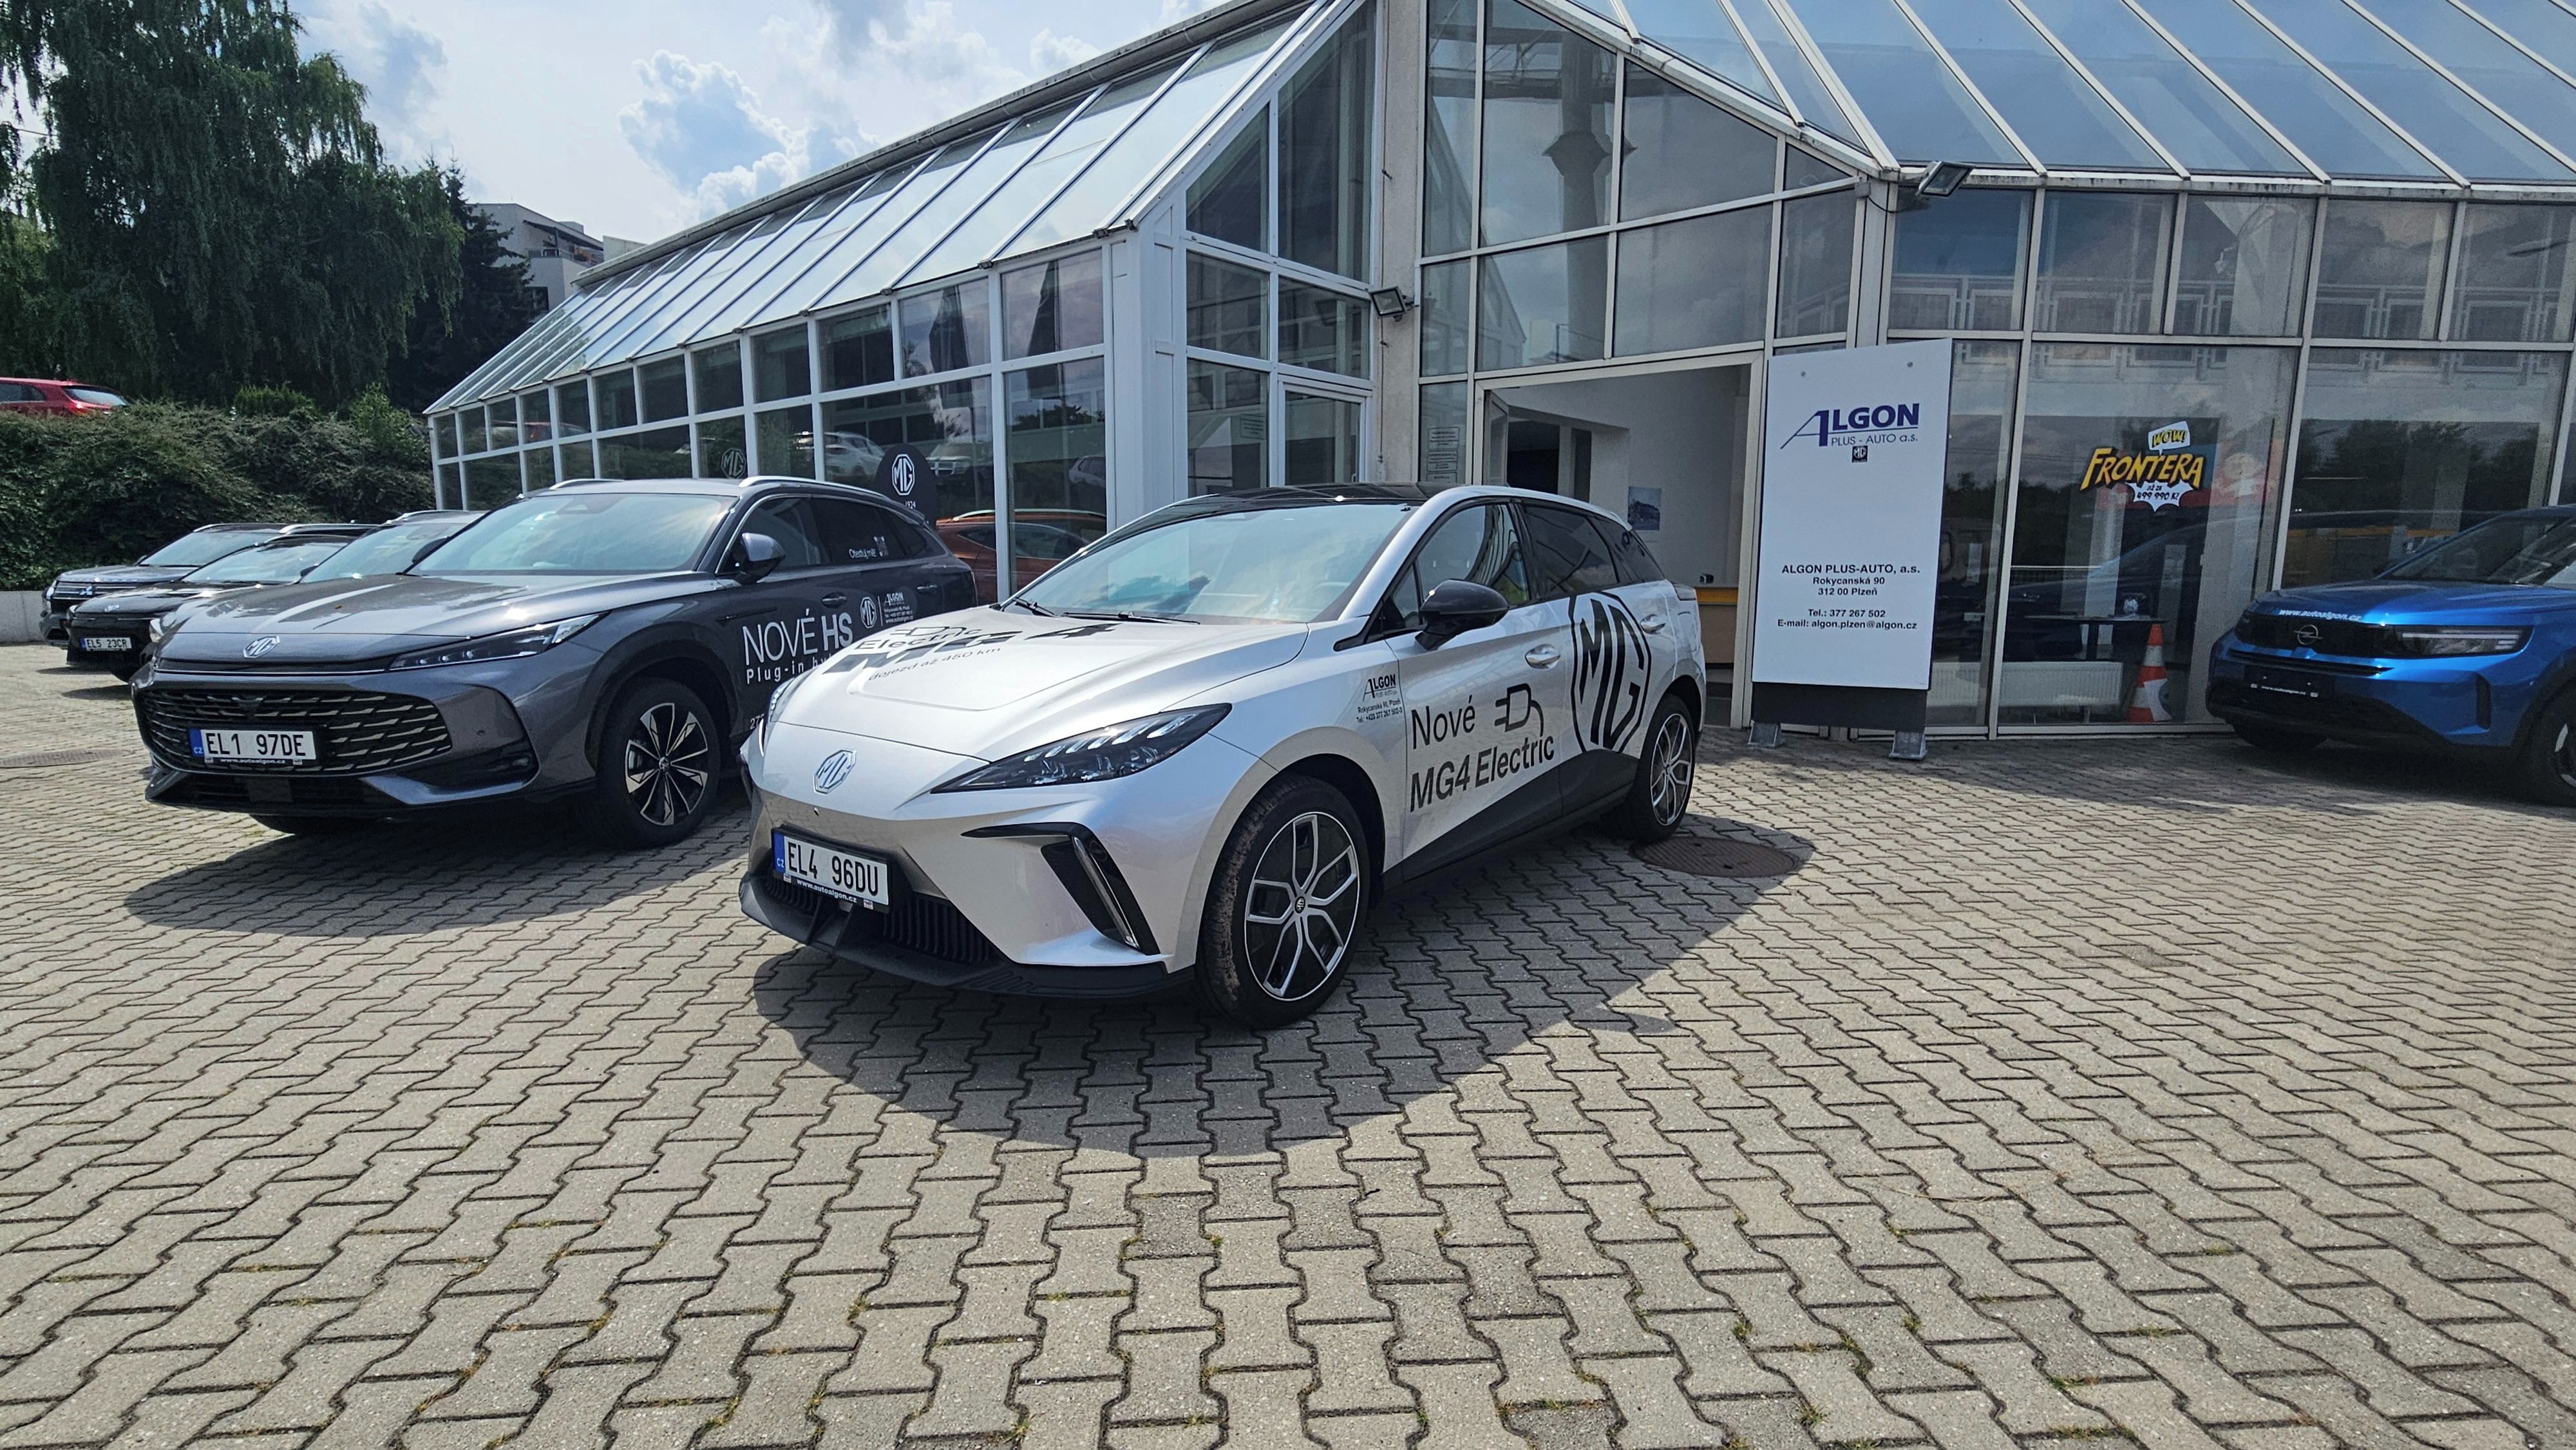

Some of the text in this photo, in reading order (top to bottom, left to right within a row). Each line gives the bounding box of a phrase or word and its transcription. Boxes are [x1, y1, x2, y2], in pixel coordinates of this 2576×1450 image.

[1780, 403, 1920, 449] ALGON
[1831, 436, 1856, 446] PLUS
[1867, 433, 1897, 444] AUTO
[1899, 434, 1918, 442] a.s.
[2152, 429, 2188, 448] WOW!
[892, 455, 915, 495] MG
[2080, 447, 2205, 491] FRONTERA
[2154, 492, 2170, 500] 990
[1781, 565, 1822, 574] ALGON
[1825, 564, 1897, 574] PLUS-AUTO,
[1813, 577, 1871, 587] Rokycanská
[1852, 587, 1877, 596] Plzeň
[861, 598, 876, 627] MG
[1808, 608, 1826, 617] Tel.:
[2278, 610, 2362, 621] www.autoalgon.cz
[1777, 619, 1917, 630] E-mail: algon.plzen@algon.cz
[743, 608, 853, 666] NOVÉ HS
[854, 629, 981, 650] Electric
[746, 661, 804, 684] Plug-in
[1571, 594, 1650, 752] MG
[1362, 674, 1396, 701] ALGON
[1411, 695, 1476, 749] Nové
[205, 733, 306, 756] EL1 97DE
[814, 749, 856, 794] MG
[1410, 735, 1555, 813] MG4 Electric
[777, 858, 784, 869] CZ
[788, 841, 878, 897] EL4 96DU
[796, 878, 858, 903] www.autoalgon.cz
